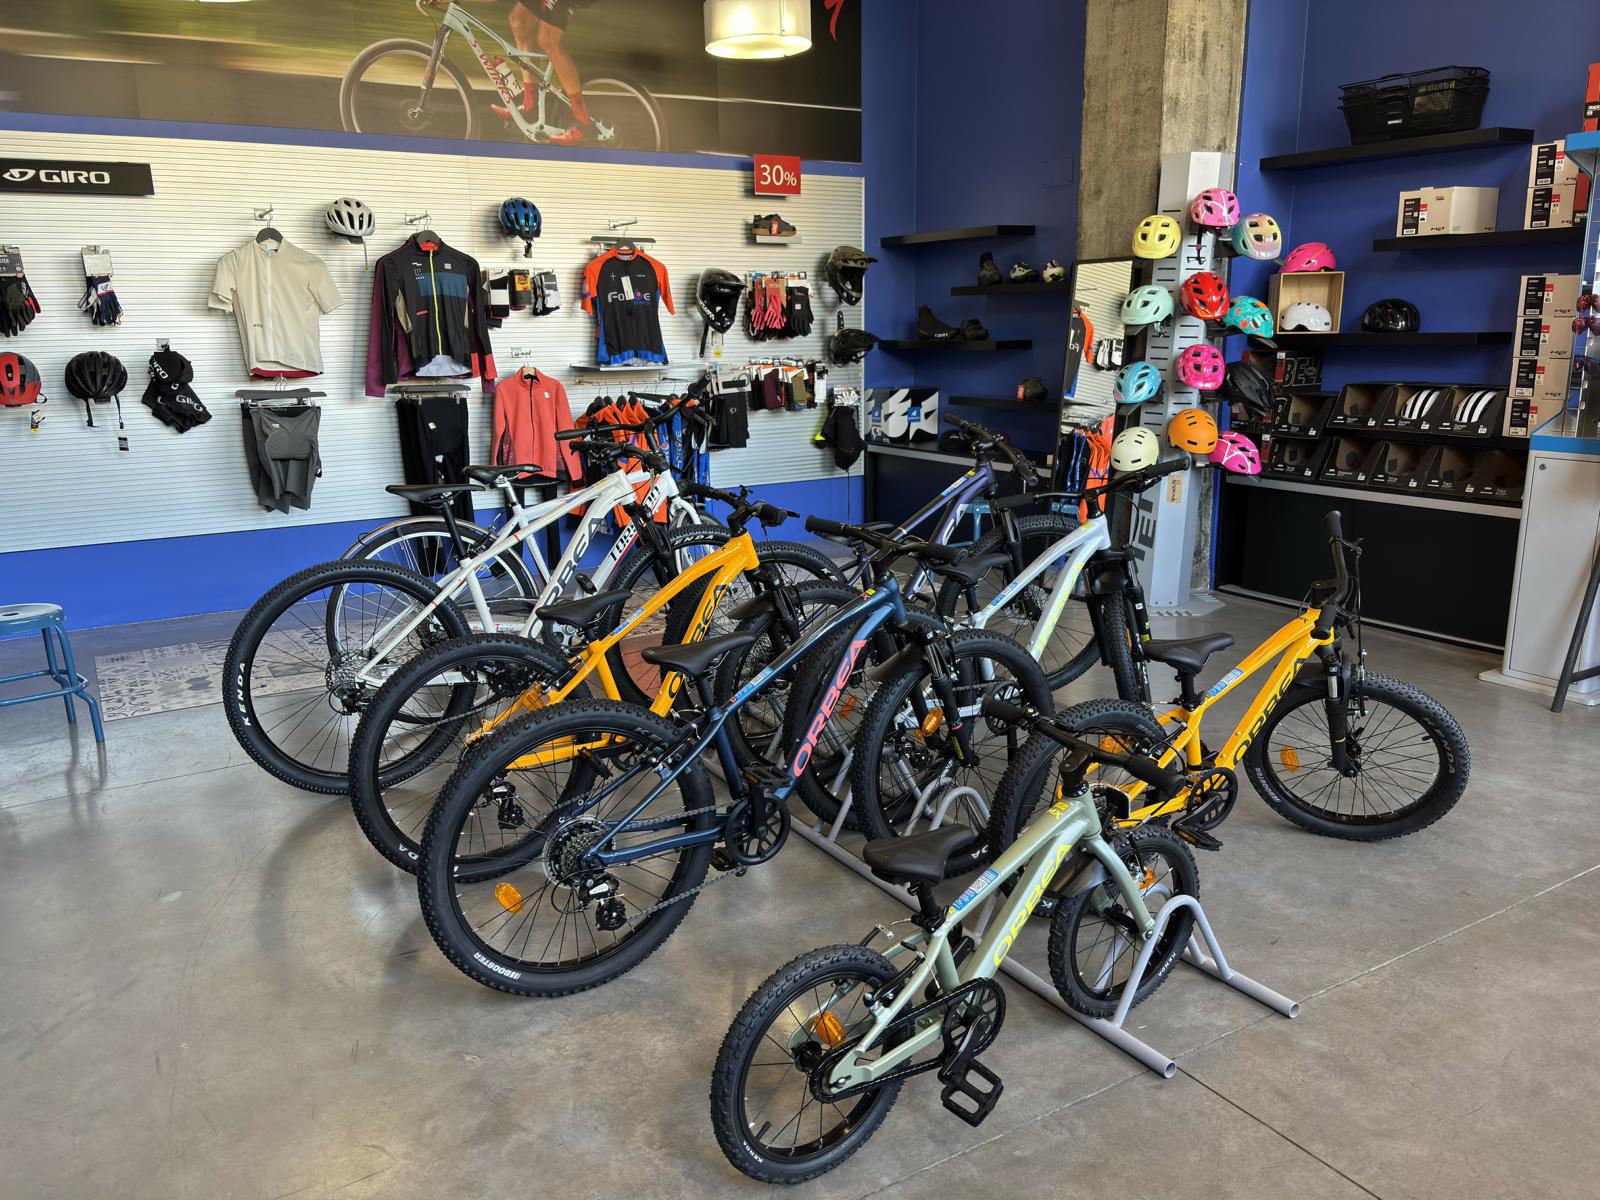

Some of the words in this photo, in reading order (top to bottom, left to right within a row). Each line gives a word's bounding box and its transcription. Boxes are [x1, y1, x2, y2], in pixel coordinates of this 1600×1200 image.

[471, 39, 512, 105] S-WORKS
[39, 169, 111, 185] GIRO
[759, 164, 798, 187] 30%
[236, 662, 252, 727] KENDA
[793, 639, 868, 777] ORBEA
[1233, 658, 1305, 766] ORBEA
[1422, 717, 1455, 774] KENDA
[993, 844, 1073, 967] ORBEA
[473, 951, 517, 979] BOOSTER
[1157, 952, 1177, 977] KENDA
[743, 1140, 763, 1163] KENDA
